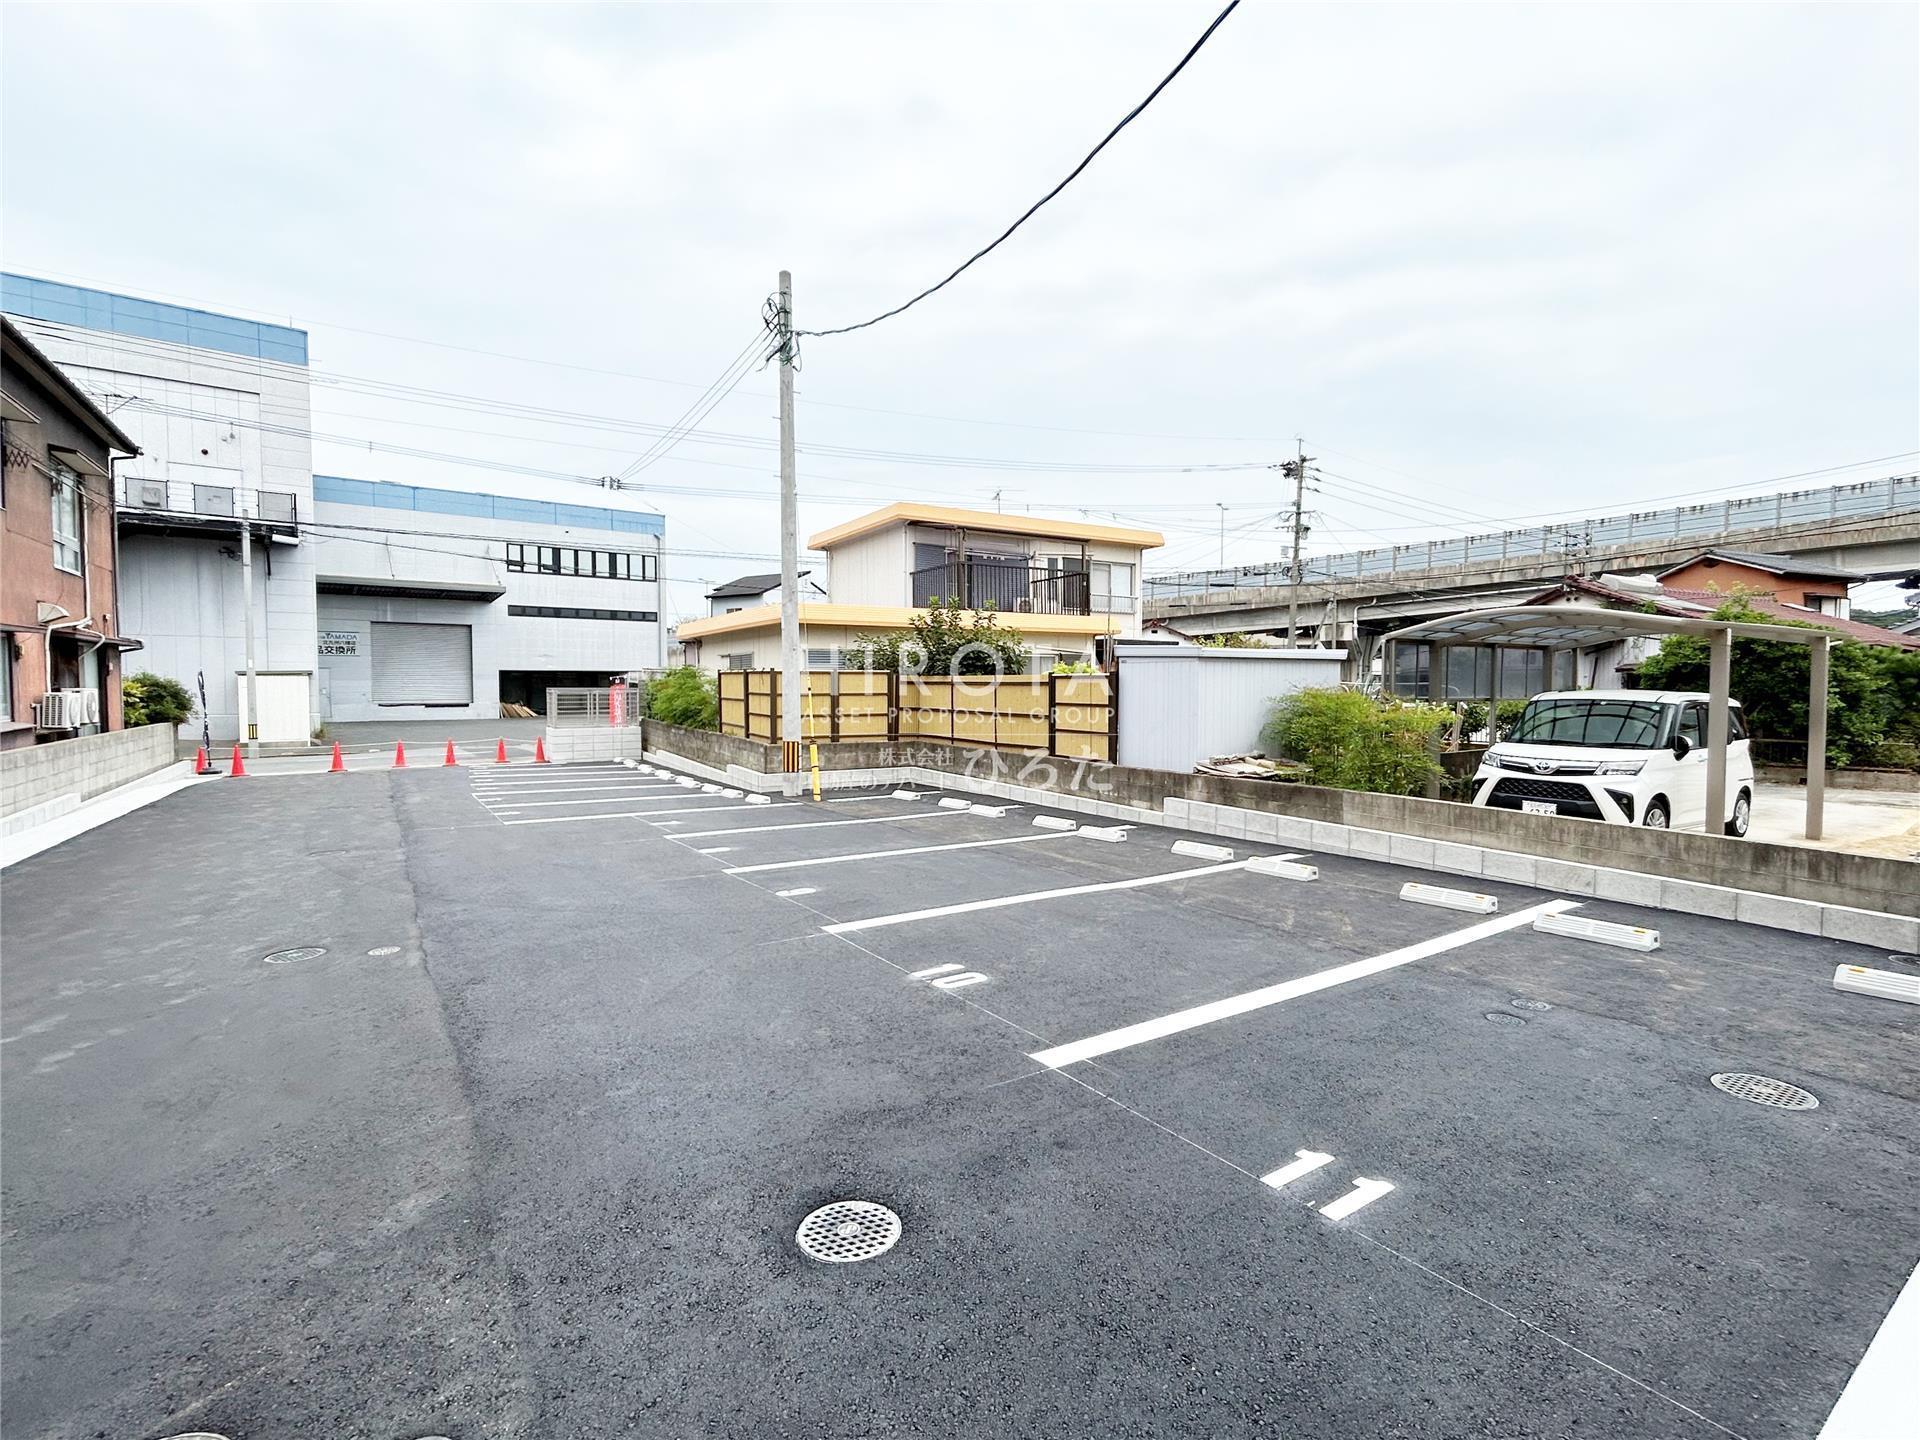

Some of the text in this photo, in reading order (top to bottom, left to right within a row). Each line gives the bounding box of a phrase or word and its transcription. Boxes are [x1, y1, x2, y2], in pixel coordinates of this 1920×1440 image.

[324, 632, 357, 641] YAMADA
[909, 963, 988, 989] 10
[1260, 1149, 1396, 1221] 11
